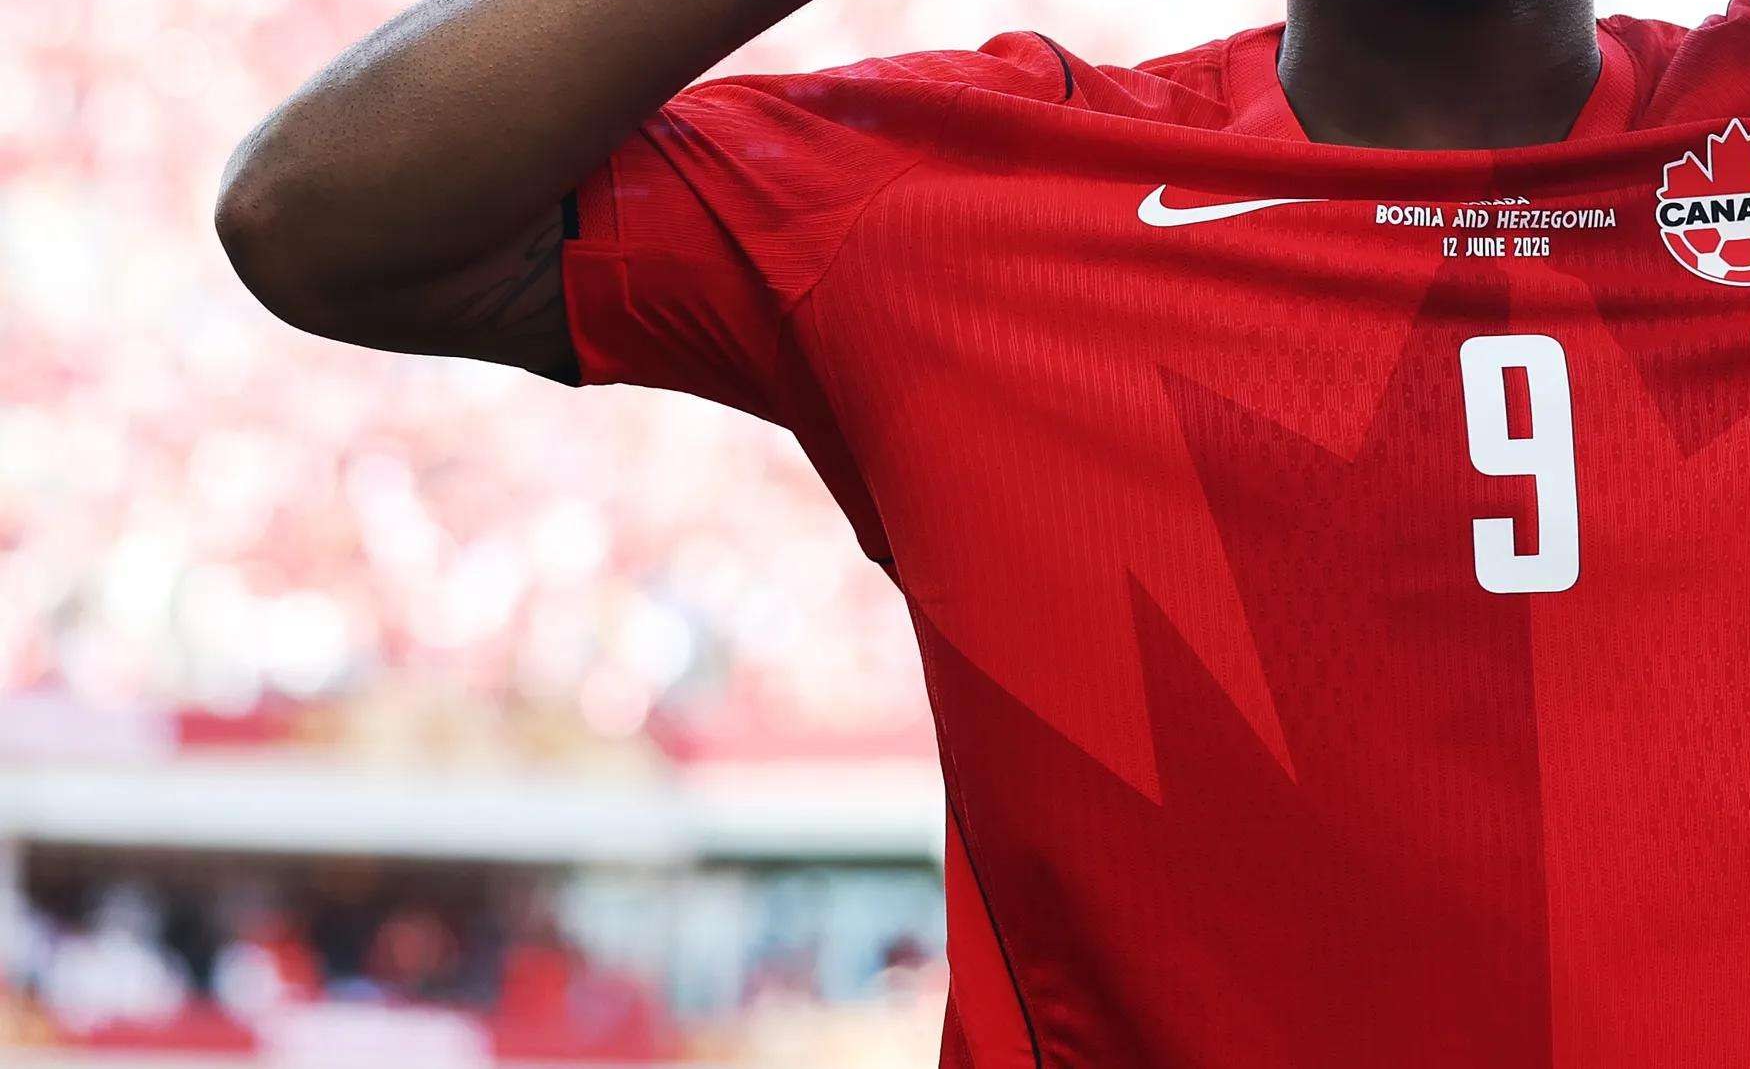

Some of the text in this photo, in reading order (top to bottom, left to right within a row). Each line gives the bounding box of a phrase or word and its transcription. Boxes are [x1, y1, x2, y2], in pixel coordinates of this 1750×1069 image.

[1376, 204, 1617, 229] BOSNIA AND HERZEGOVINA
[1442, 237, 1550, 257] 12 JUNE 2026
[1459, 334, 1580, 594] 9
